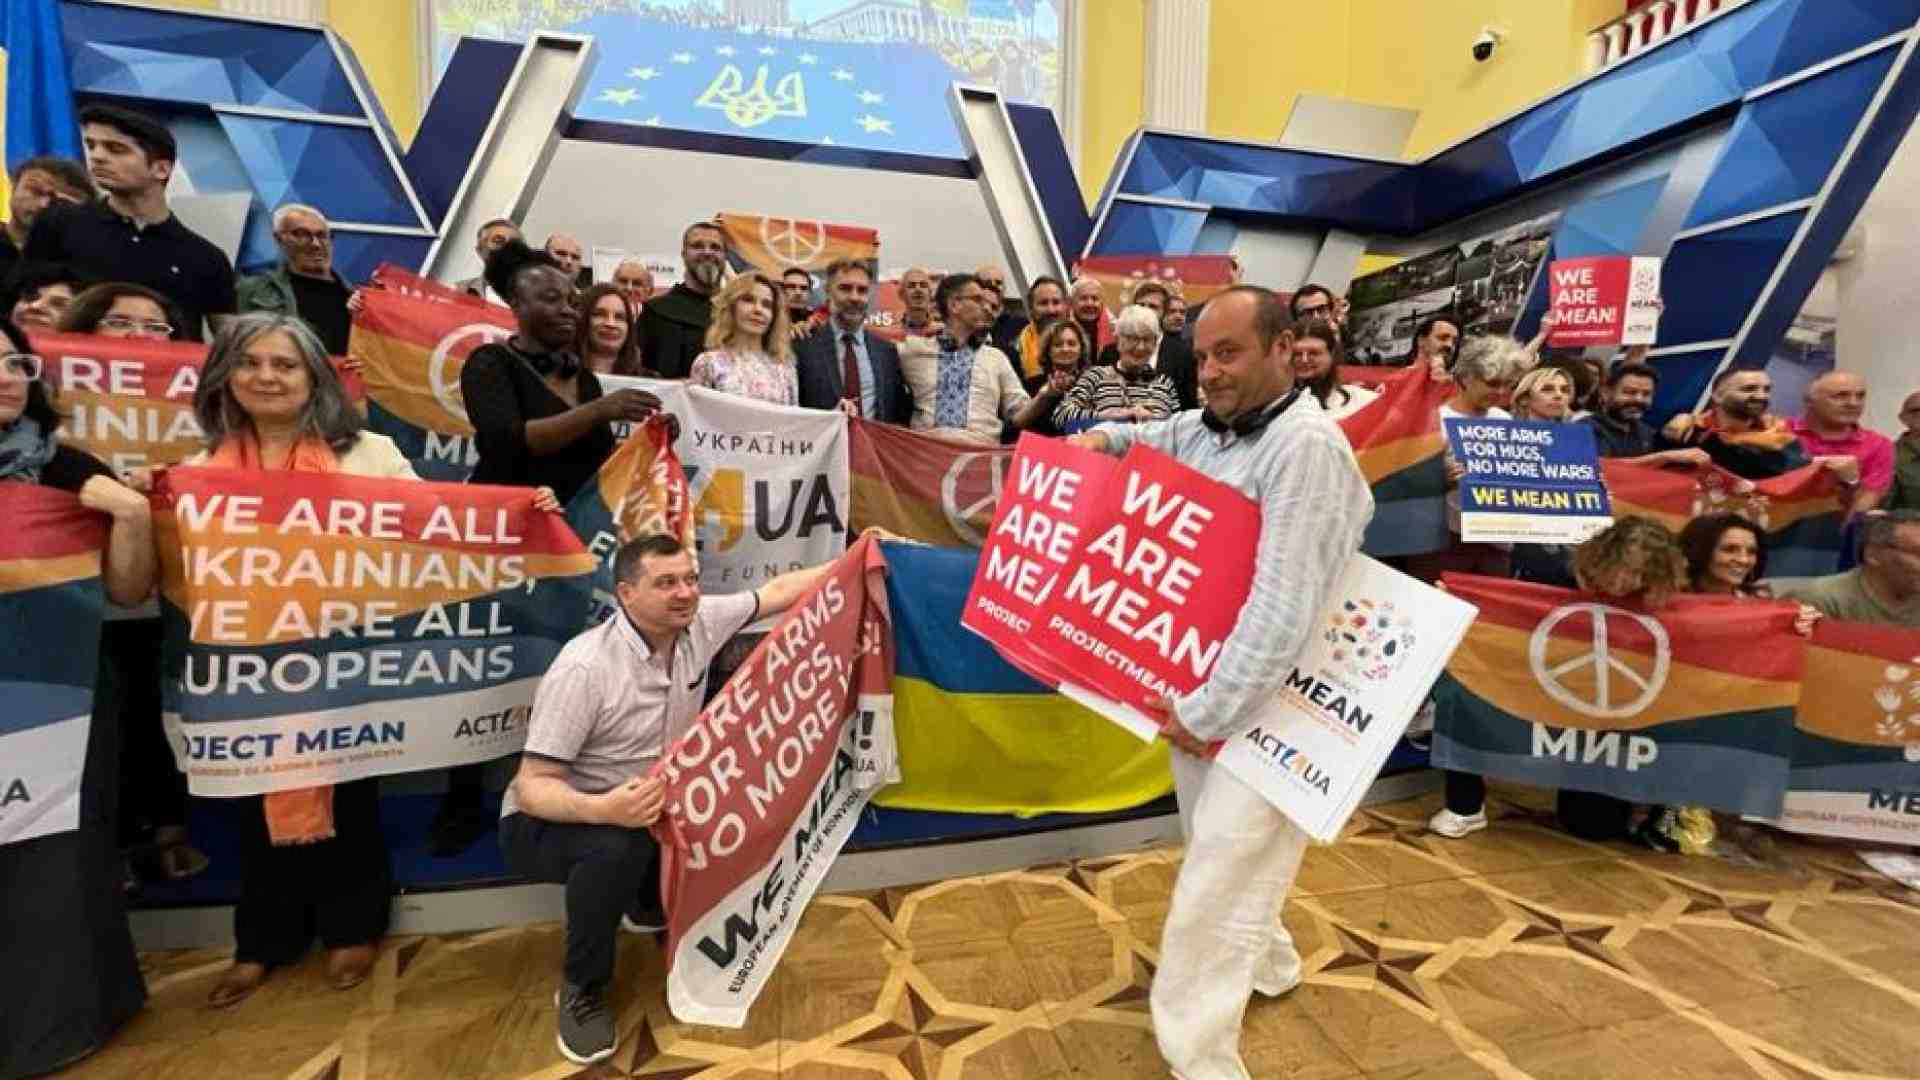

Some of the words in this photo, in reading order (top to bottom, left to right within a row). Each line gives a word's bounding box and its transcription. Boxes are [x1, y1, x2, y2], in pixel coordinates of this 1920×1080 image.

[1554, 268, 1593, 286] WE
[1555, 288, 1599, 305] ARE
[1554, 306, 1617, 325] MEAN!
[61, 356, 146, 397] RE
[694, 429, 814, 456] УКРАЇНИ
[1457, 425, 1508, 441] MORE
[1510, 428, 1553, 445] ARMS
[1463, 441, 1497, 457] FOR
[1017, 456, 1082, 513] WE
[1467, 459, 1493, 474] NO
[1495, 461, 1540, 479] MORE
[1541, 463, 1596, 481] WARS!
[277, 498, 406, 540] ARE
[419, 504, 523, 544] ALL
[1122, 470, 1215, 550] WE
[1472, 486, 1509, 506] WE
[1511, 488, 1570, 510] MEAN
[1573, 492, 1602, 511] IT!
[996, 503, 1080, 564] ARE
[1085, 523, 1203, 606] ARE
[265, 600, 398, 639] ARE
[412, 601, 513, 638] ALL
[766, 576, 845, 685] ARMS
[1063, 564, 1222, 679] MEAN
[178, 645, 513, 695] UROPEANS
[1285, 667, 1374, 734] MEAN
[185, 733, 284, 762] JECT
[296, 721, 406, 755] MEAN
[745, 688, 839, 820] MORE
[1531, 720, 1660, 772] МИР
[670, 746, 745, 826] OR
[696, 857, 784, 969] WE
